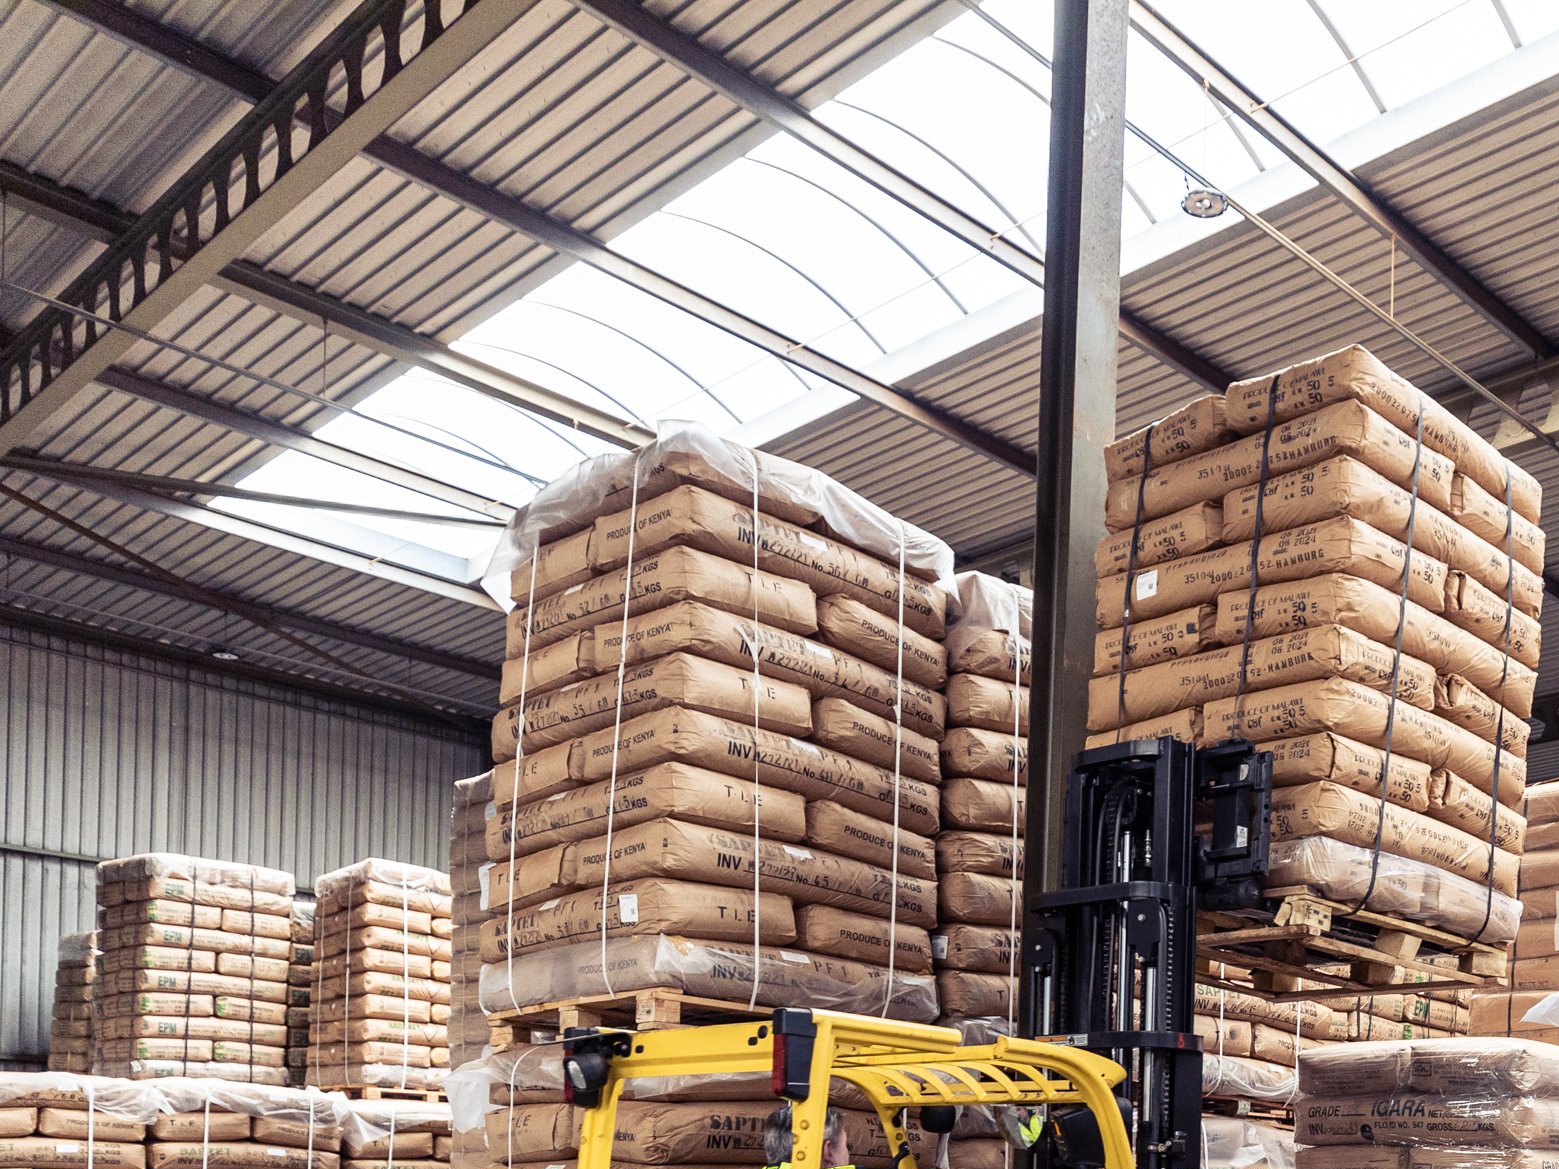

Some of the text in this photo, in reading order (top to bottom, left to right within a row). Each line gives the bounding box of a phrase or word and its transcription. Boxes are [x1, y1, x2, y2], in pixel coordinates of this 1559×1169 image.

[648, 509, 671, 525] KENYA
[645, 582, 661, 595] KGS
[914, 603, 932, 616] KGS
[914, 647, 938, 666] KENYA
[916, 710, 933, 723] KGS
[632, 730, 654, 745] KENYA
[852, 722, 932, 761] PRODUCE KENYA
[728, 741, 752, 758] INV
[909, 803, 928, 815] KGS
[624, 843, 645, 855] KENYA
[844, 826, 926, 859] PRODUCE KENYA
[717, 853, 742, 870] INV
[904, 902, 922, 912] KGS
[840, 930, 922, 954] PRODUCE KENYA
[1308, 1099, 1425, 1118] GRADE IGARA
[707, 1135, 731, 1148] INV
